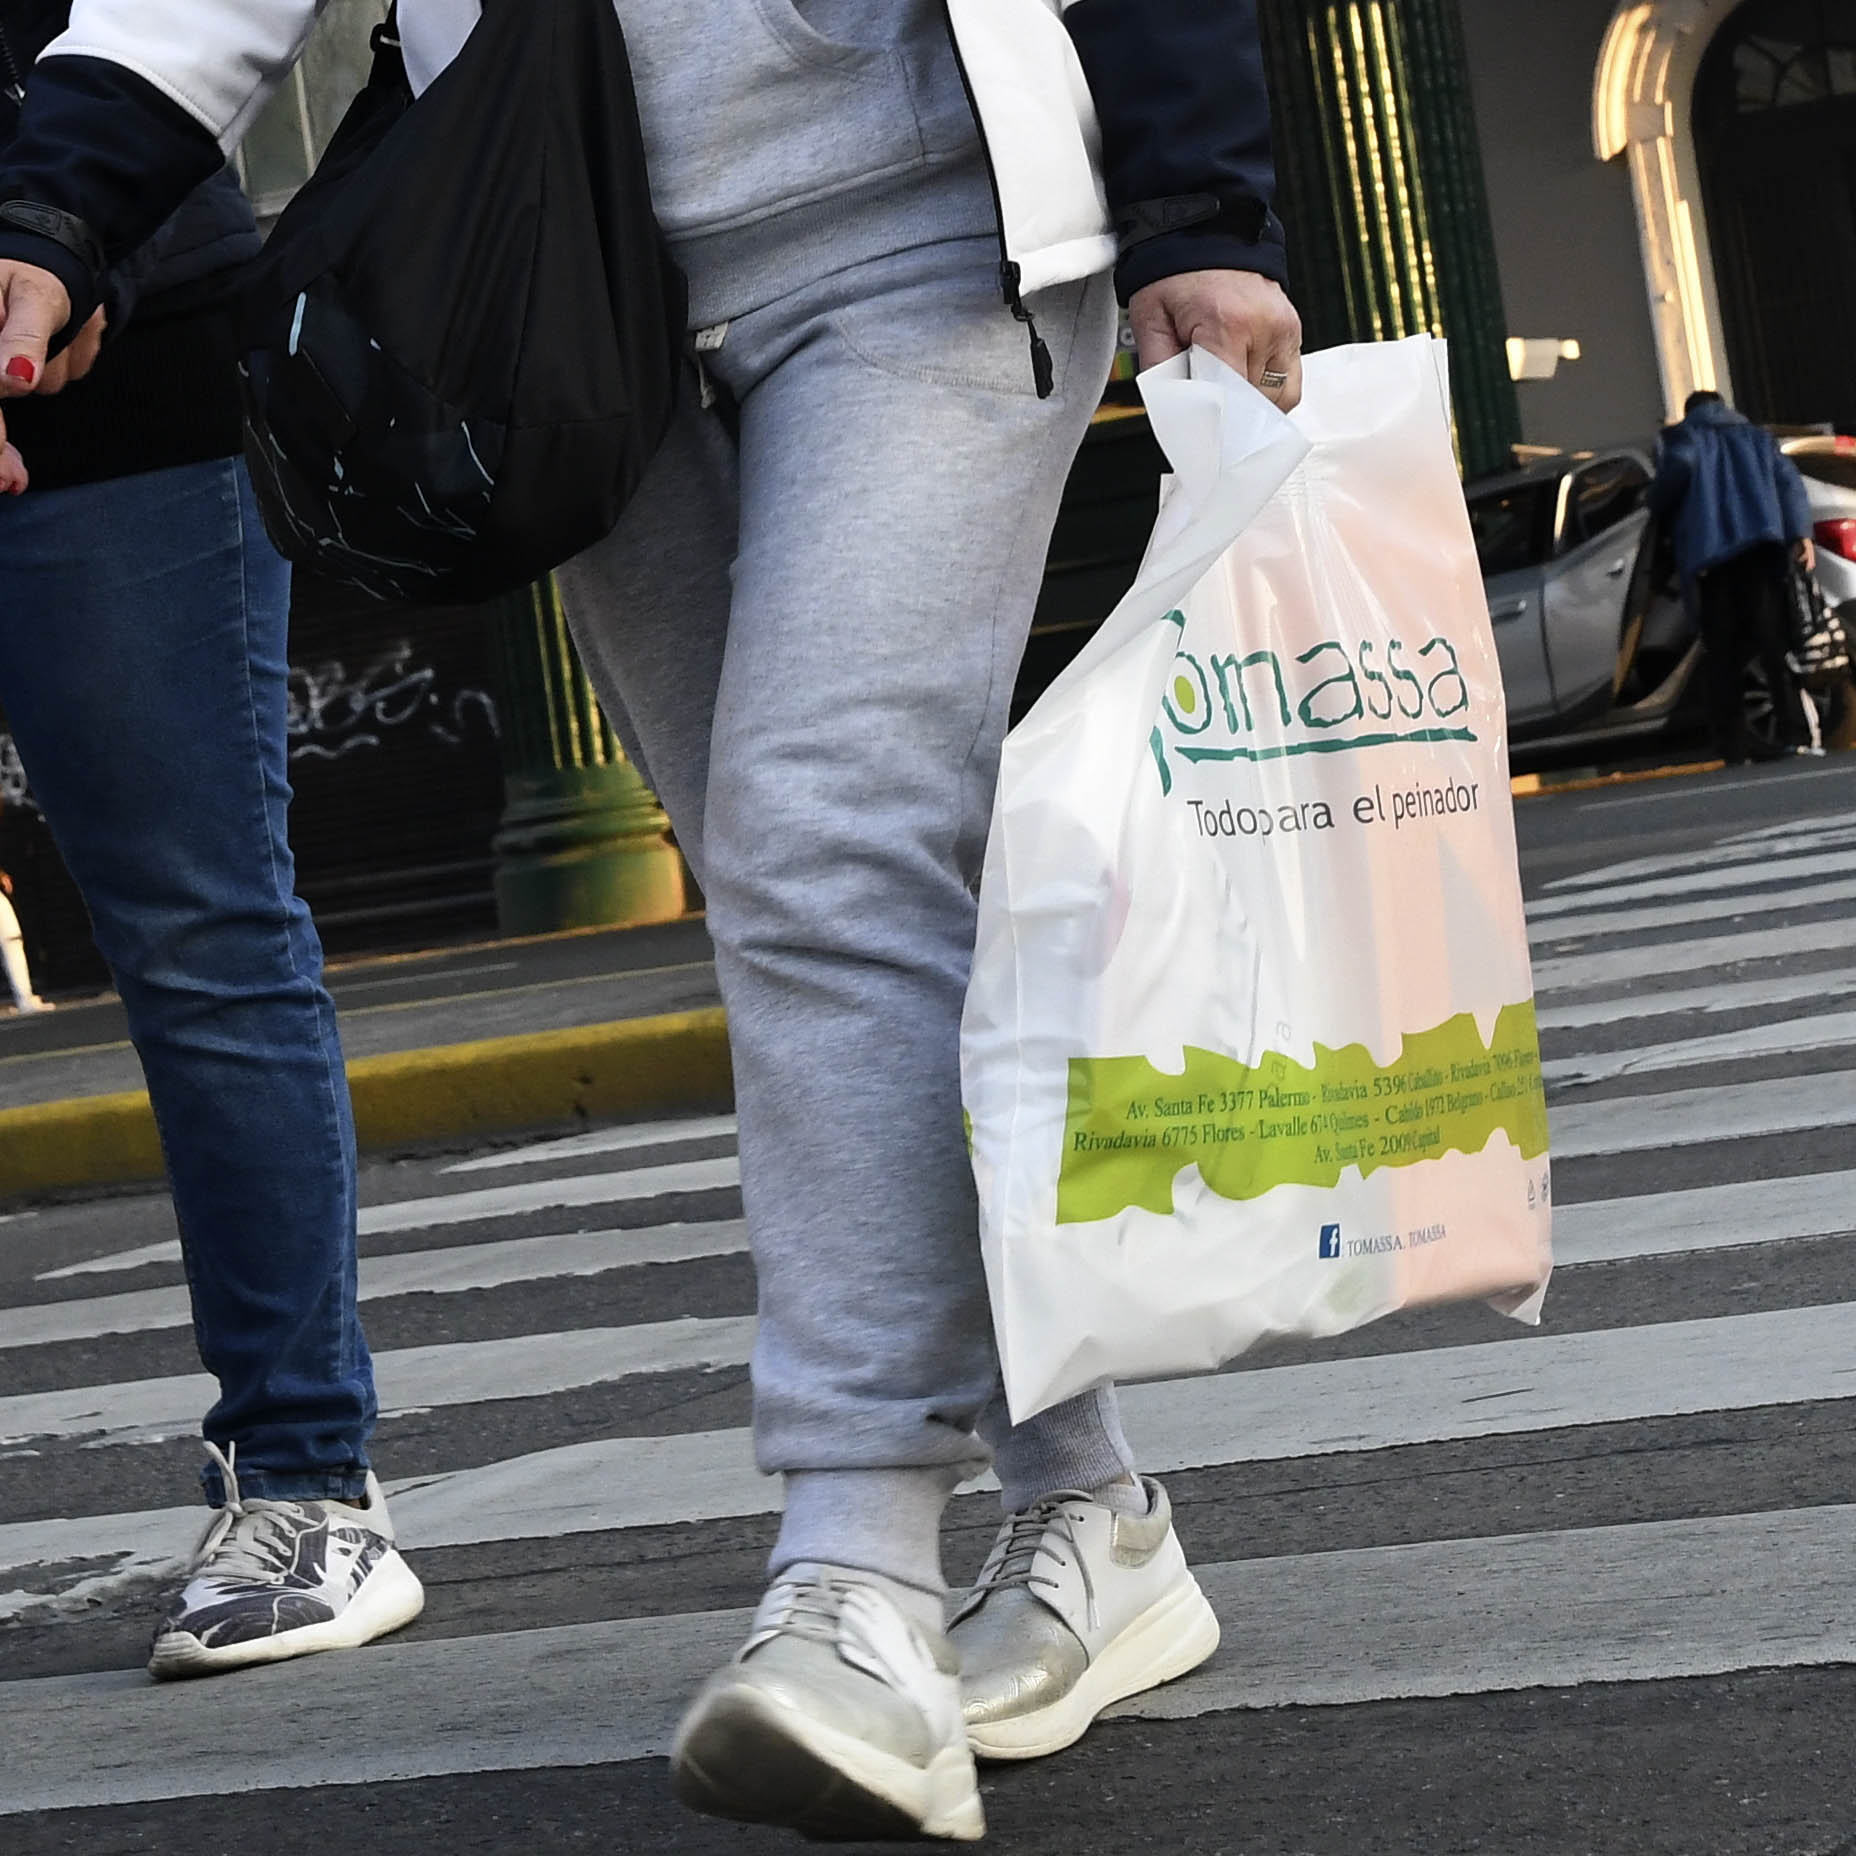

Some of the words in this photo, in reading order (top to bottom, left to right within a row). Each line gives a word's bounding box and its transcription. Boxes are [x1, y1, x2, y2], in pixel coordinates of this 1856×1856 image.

[1187, 798, 1258, 838] Todo
[1352, 784, 1387, 825] el
[1392, 776, 1479, 830] peinador
[1126, 1101, 1149, 1121] Av.
[1154, 1097, 1193, 1118] Santa
[1198, 1094, 1216, 1115] Fe
[1219, 1090, 1254, 1113] 3377
[1073, 1130, 1156, 1152] Rivadavia
[1162, 1125, 1198, 1147] 6775
[1203, 1122, 1245, 1144] Flores
[1258, 1116, 1308, 1140] Lavalle
